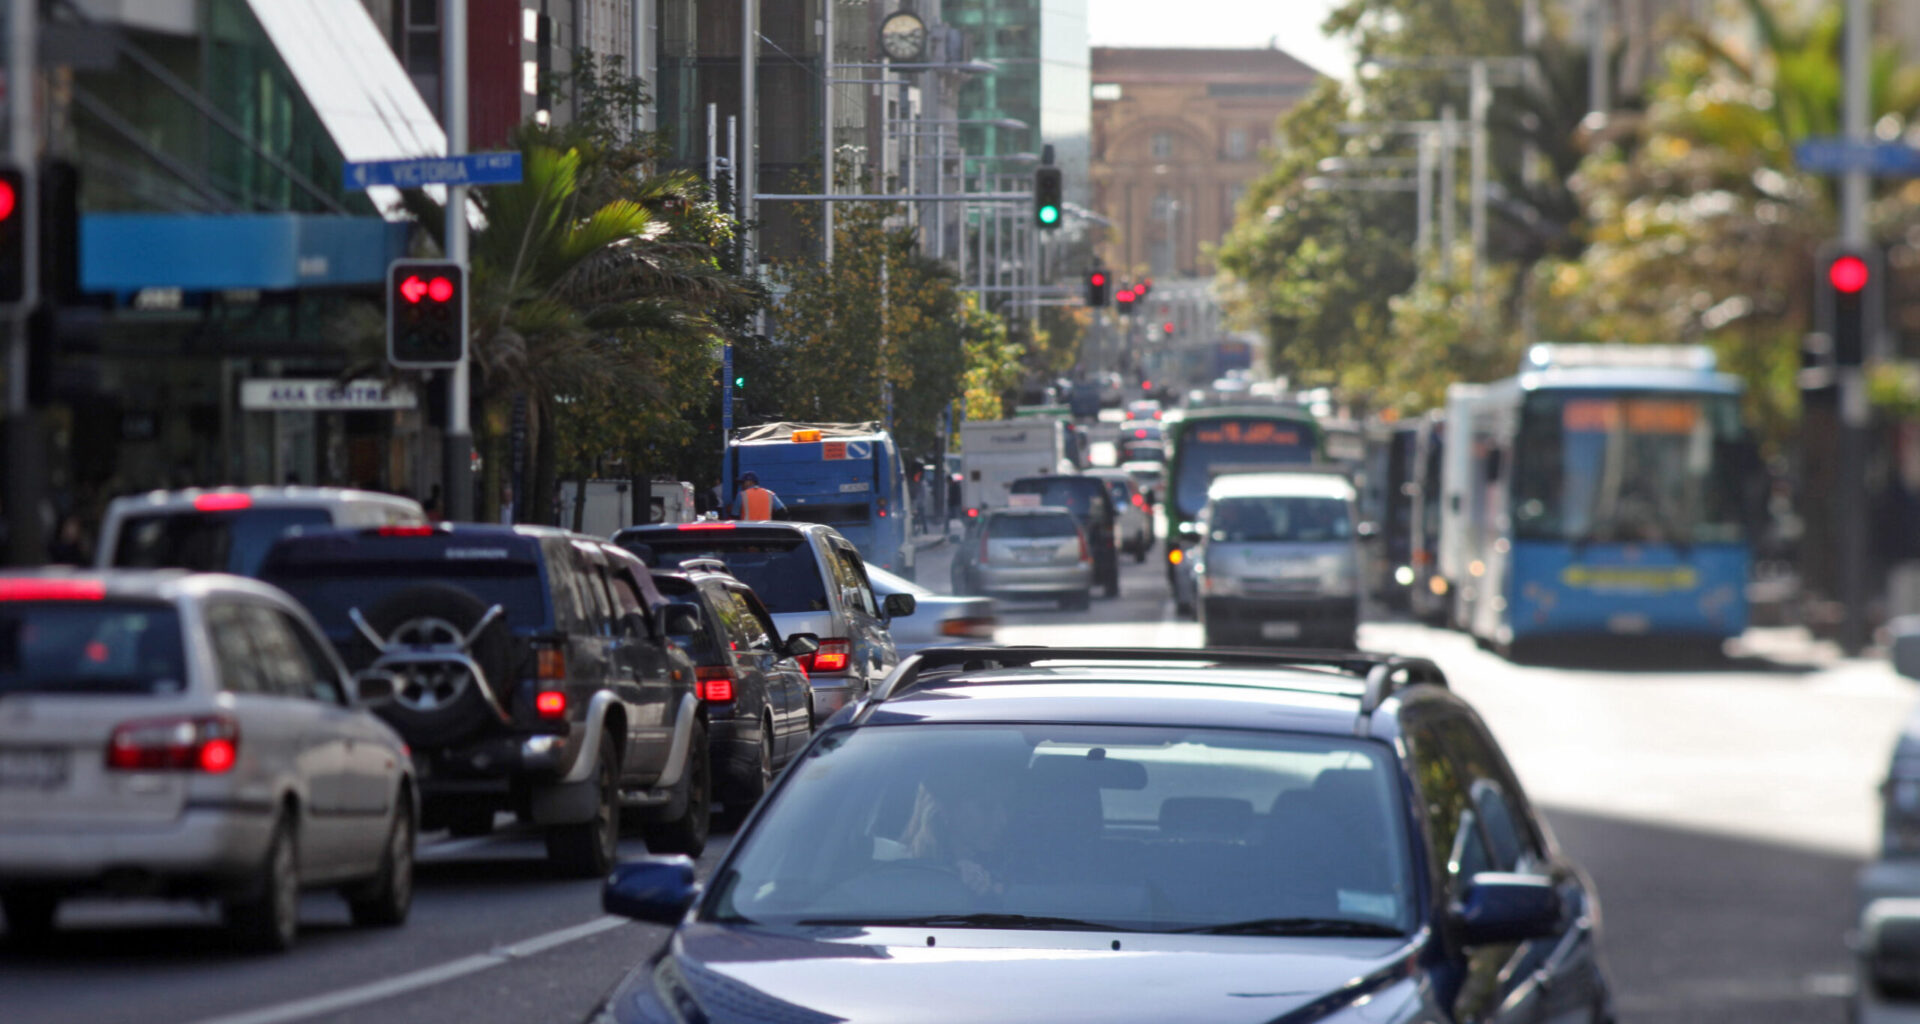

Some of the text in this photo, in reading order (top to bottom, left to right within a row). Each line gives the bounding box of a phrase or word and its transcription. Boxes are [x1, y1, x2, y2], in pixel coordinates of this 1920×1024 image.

[390, 160, 468, 184] VICTORIA
[489, 155, 513, 169] WEST
[313, 386, 389, 402] CENTR
